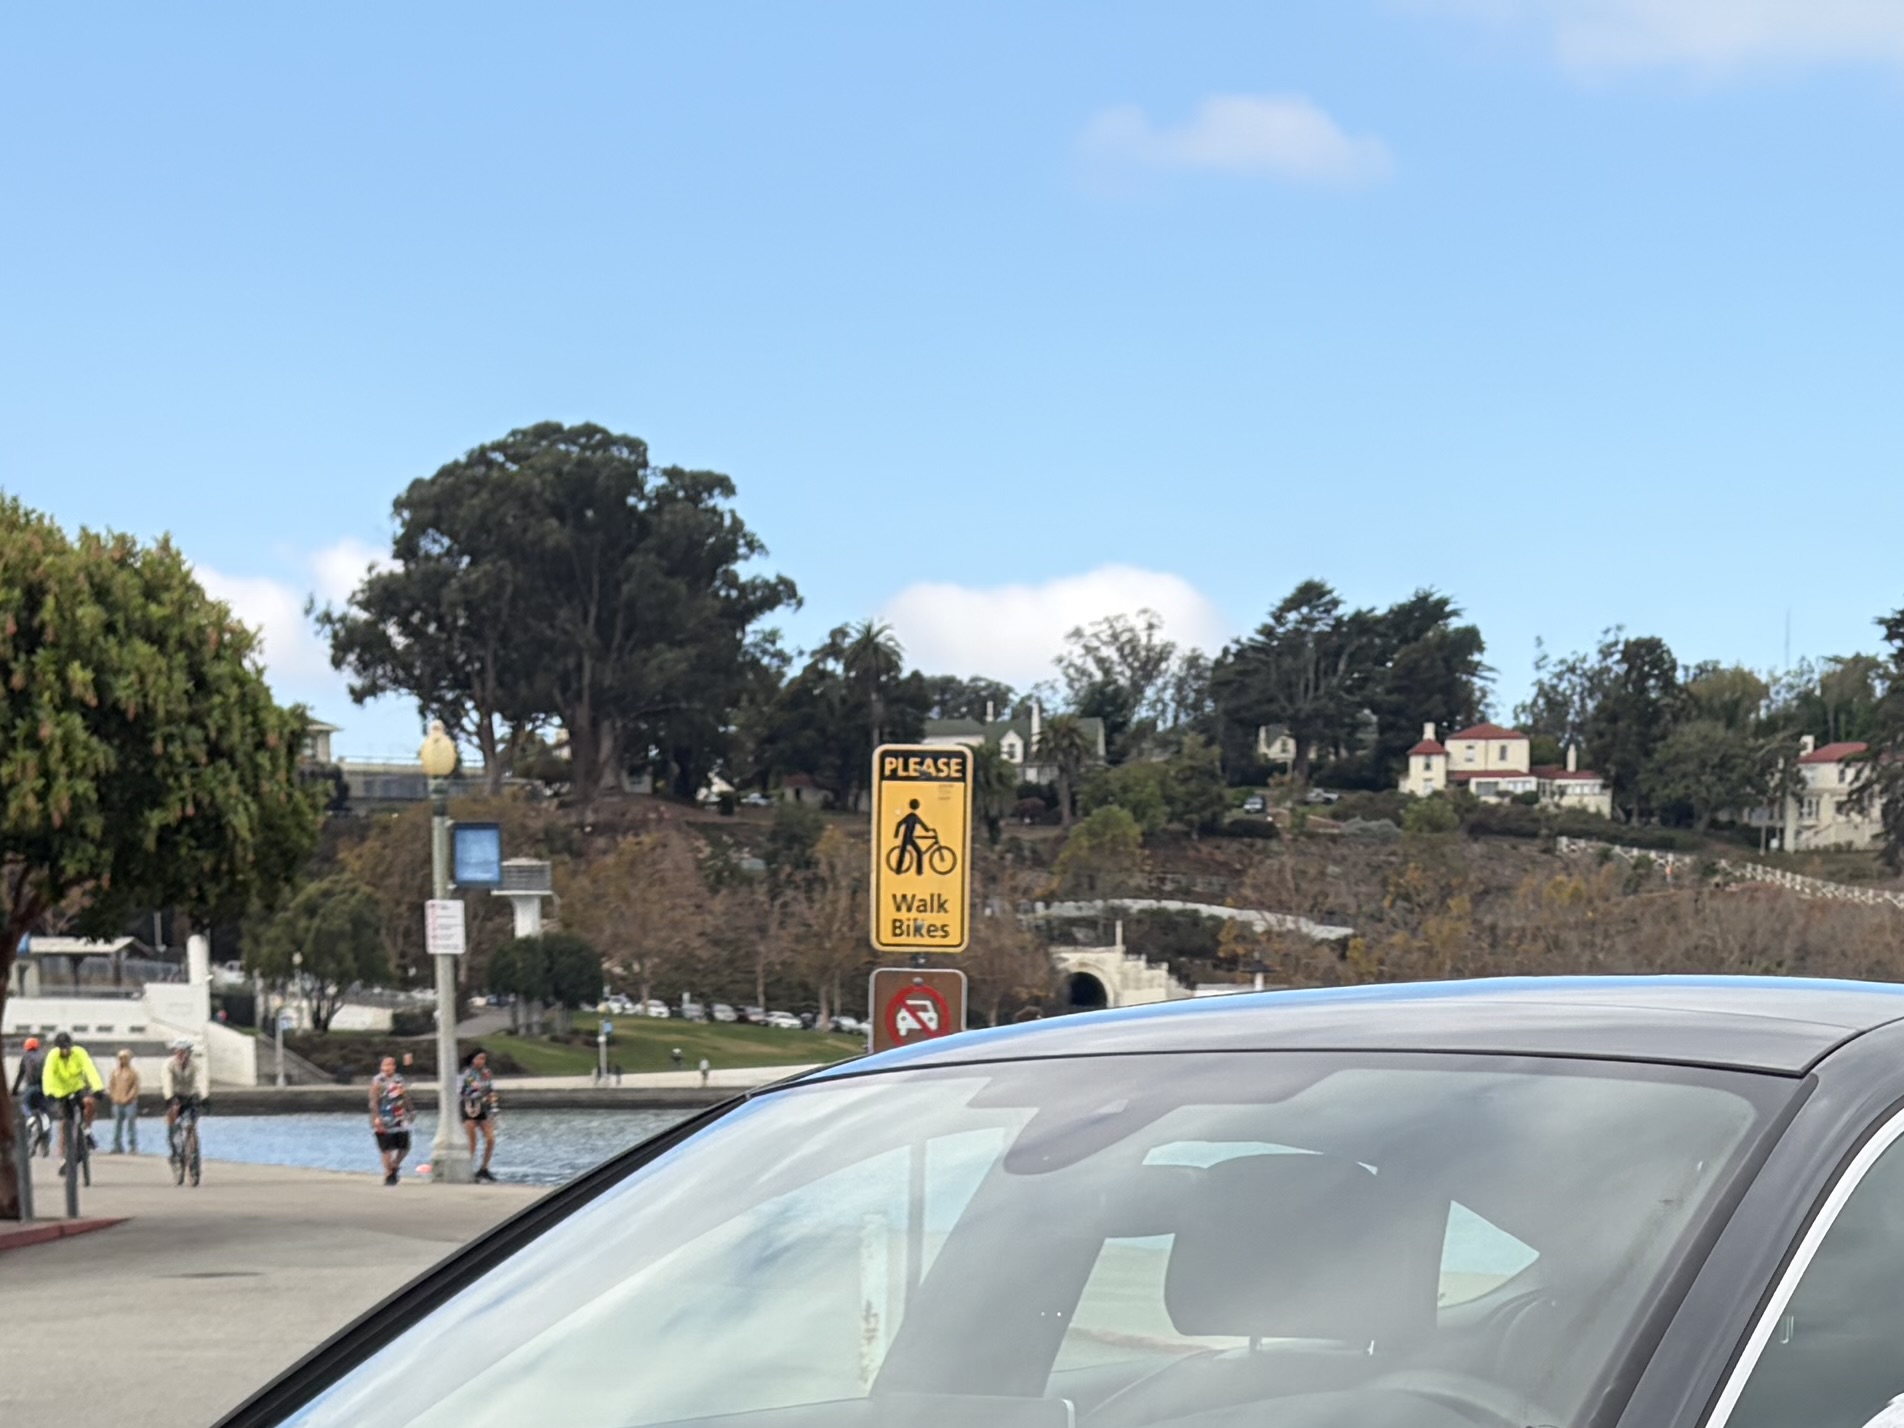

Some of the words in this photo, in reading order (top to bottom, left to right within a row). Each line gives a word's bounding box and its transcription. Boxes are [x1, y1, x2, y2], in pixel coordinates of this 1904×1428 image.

[884, 757, 964, 778] PLEASE
[892, 893, 950, 915] Walk
[892, 917, 951, 939] Bikes
